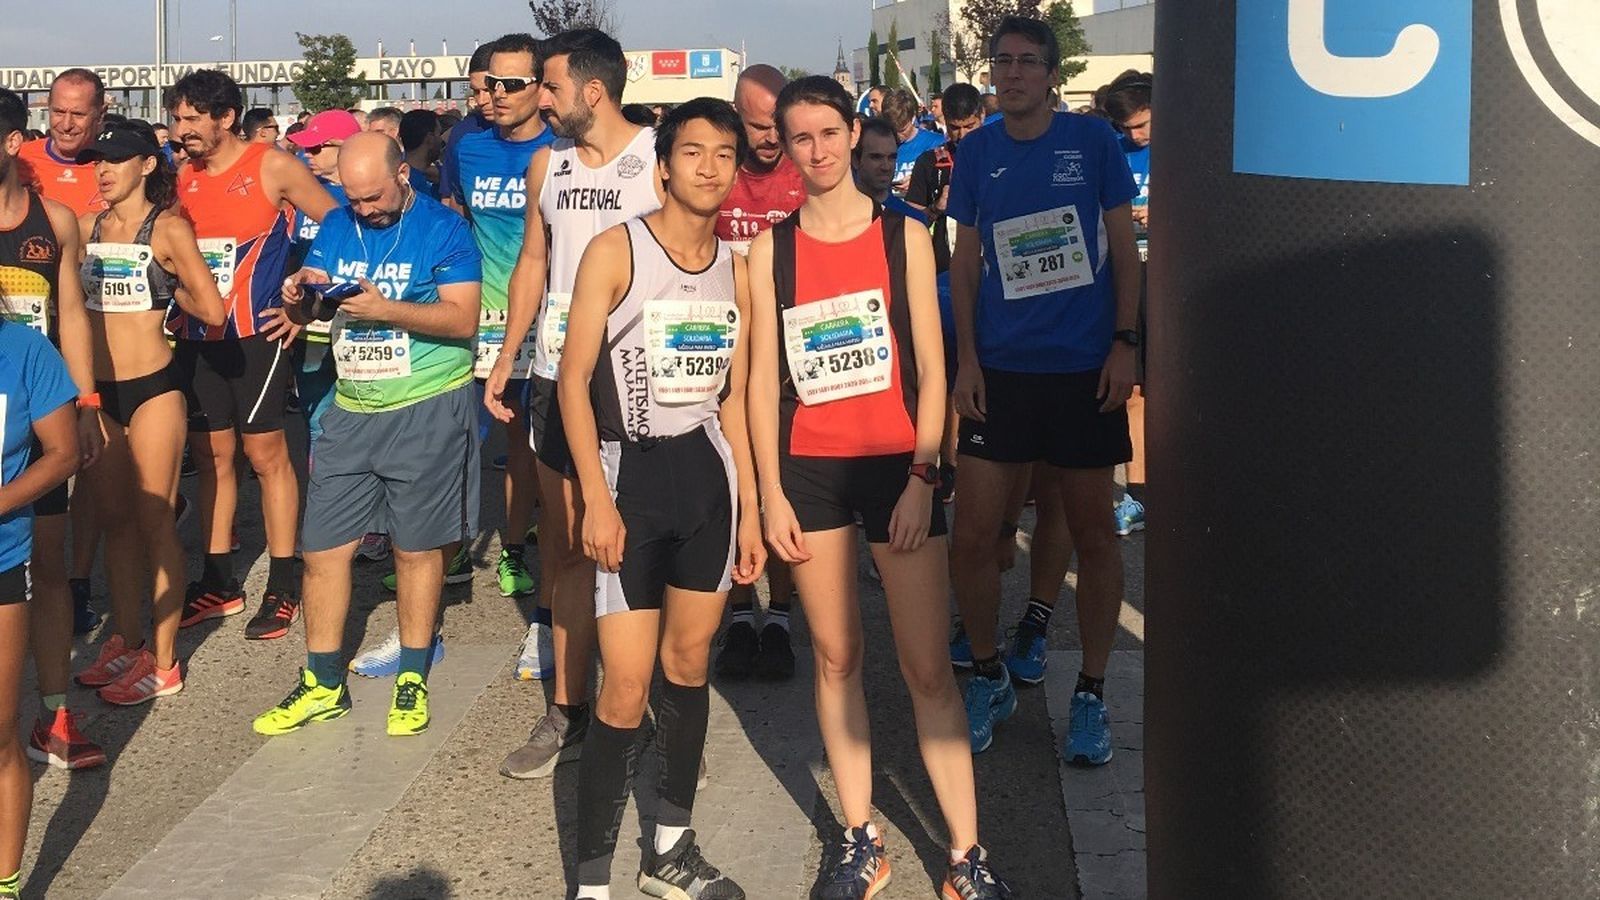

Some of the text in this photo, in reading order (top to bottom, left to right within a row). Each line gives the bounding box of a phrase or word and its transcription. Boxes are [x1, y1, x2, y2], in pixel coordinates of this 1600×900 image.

[96, 65, 196, 86] EPORTIVA
[380, 59, 435, 79] RAYO
[475, 176, 500, 191] WE
[338, 258, 412, 280] WE ARE
[1038, 253, 1065, 273] 287
[104, 282, 132, 296] 5191
[359, 346, 393, 361] 5259
[828, 347, 876, 374] 5238
[634, 346, 651, 437] ATLETISMO
